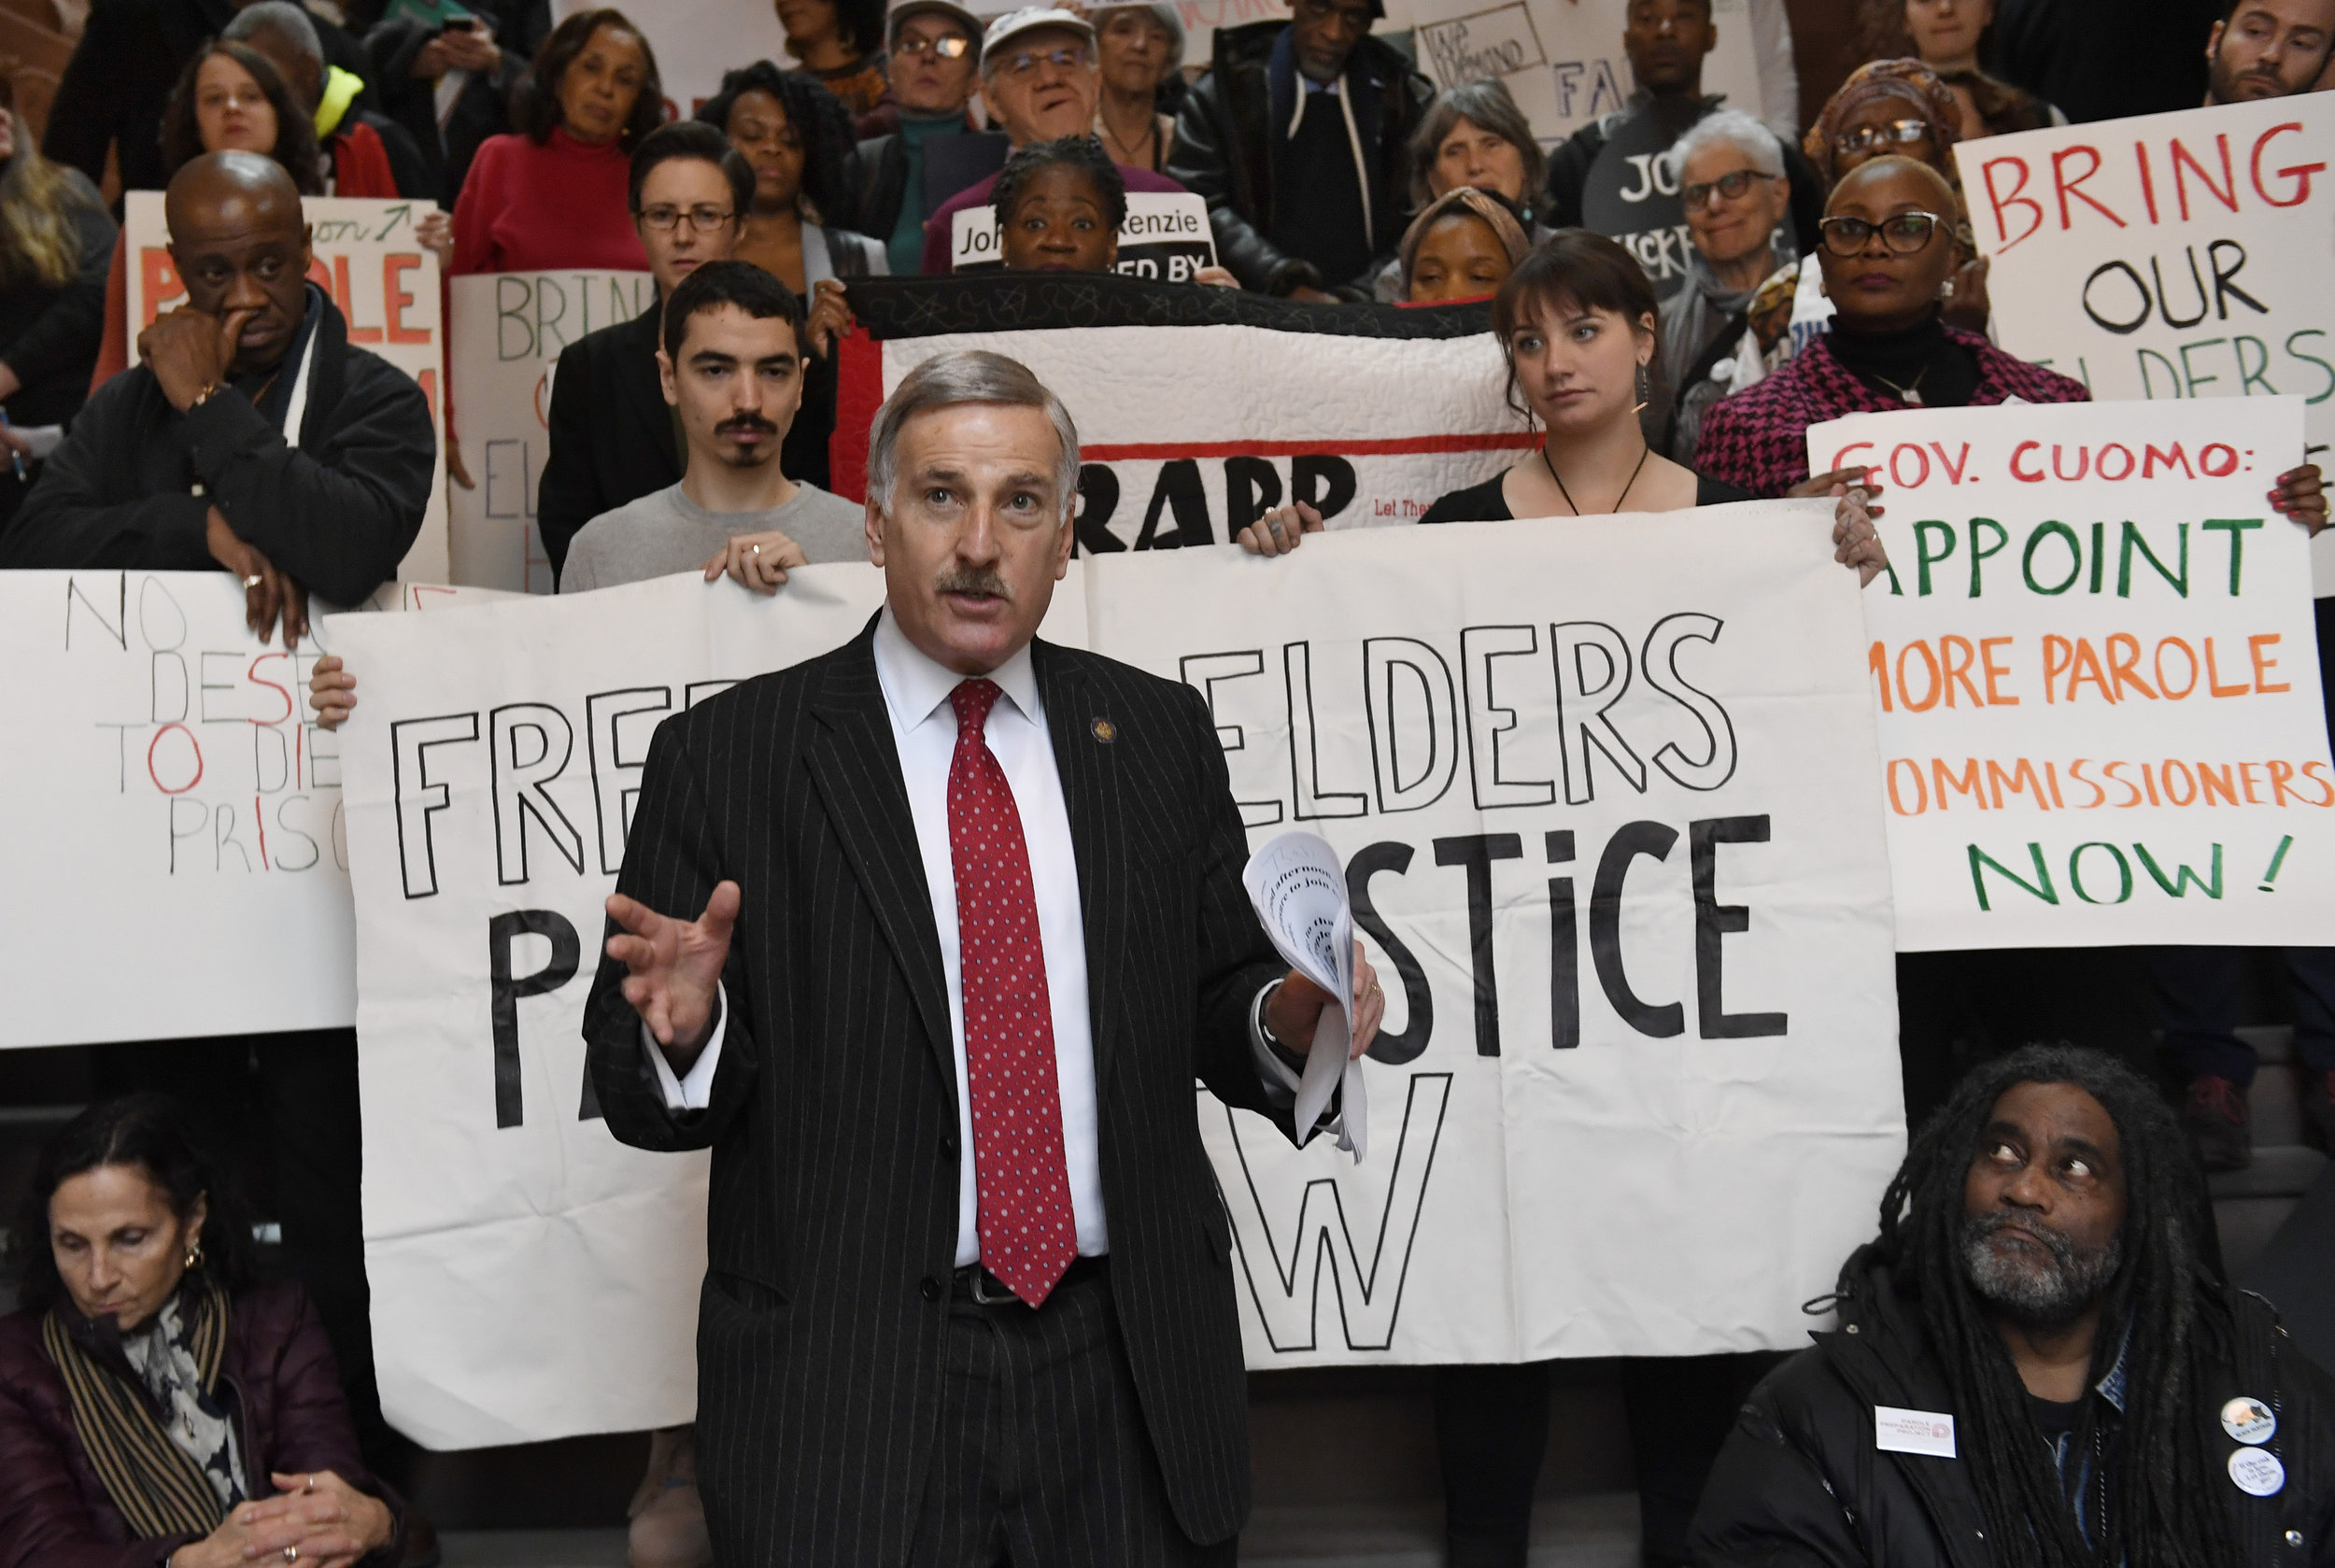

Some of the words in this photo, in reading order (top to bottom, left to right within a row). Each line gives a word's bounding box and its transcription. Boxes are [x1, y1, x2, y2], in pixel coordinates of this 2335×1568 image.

[1982, 122, 2327, 255] BRING
[2083, 239, 2270, 334] OUR
[1832, 442, 1980, 488] GOV.
[2009, 441, 2255, 482] CUOMO:
[1070, 455, 1357, 560] RAPP
[65, 570, 188, 652] NO
[2043, 632, 2291, 705] PAROLE
[94, 723, 204, 794] TO
[255, 722, 343, 794] DIE
[1887, 757, 2334, 816] OMMISSIONERS
